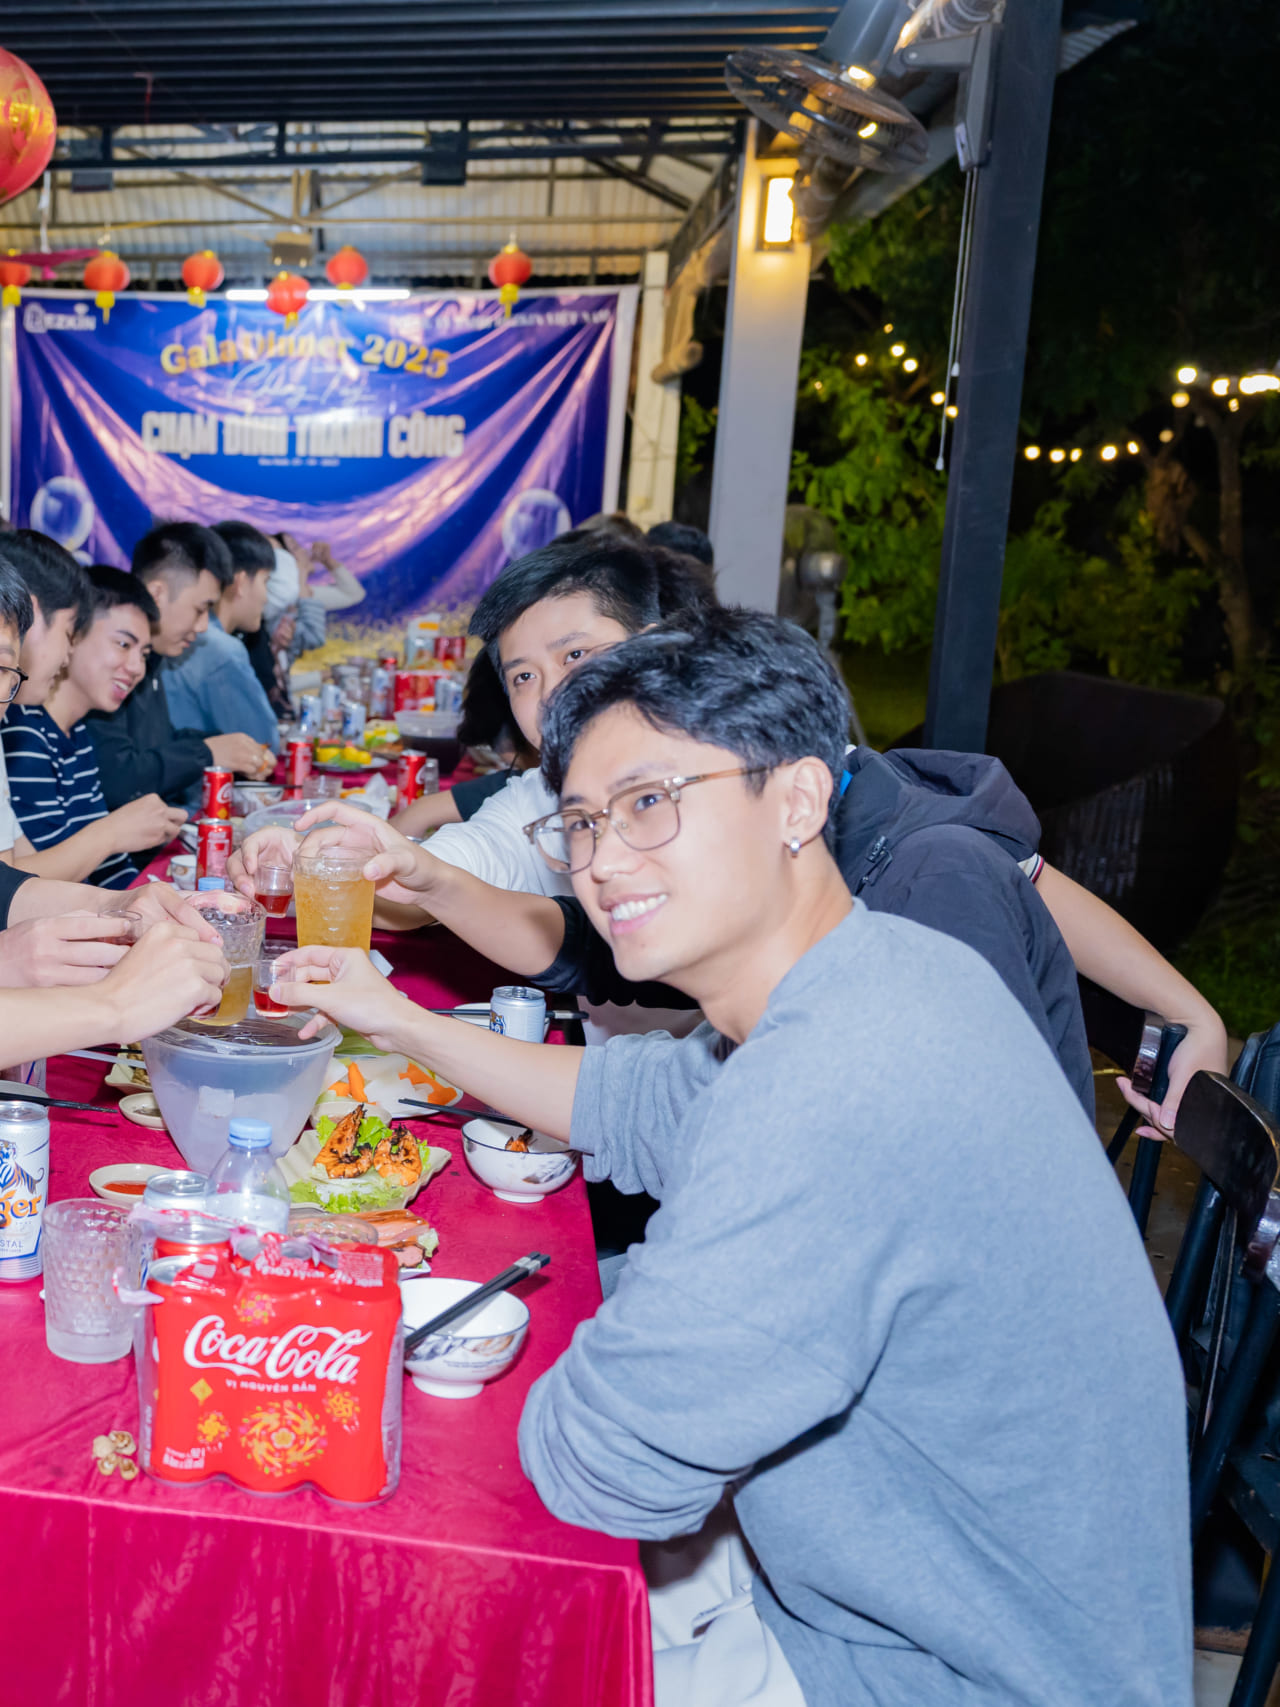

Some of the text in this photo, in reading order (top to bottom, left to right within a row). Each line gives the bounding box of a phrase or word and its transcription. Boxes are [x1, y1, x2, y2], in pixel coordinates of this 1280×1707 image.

[160, 334, 238, 375] Gala
[361, 333, 451, 378] 2025
[387, 410, 466, 459] CÔNG
[184, 1315, 373, 1384] Coca-Cola
